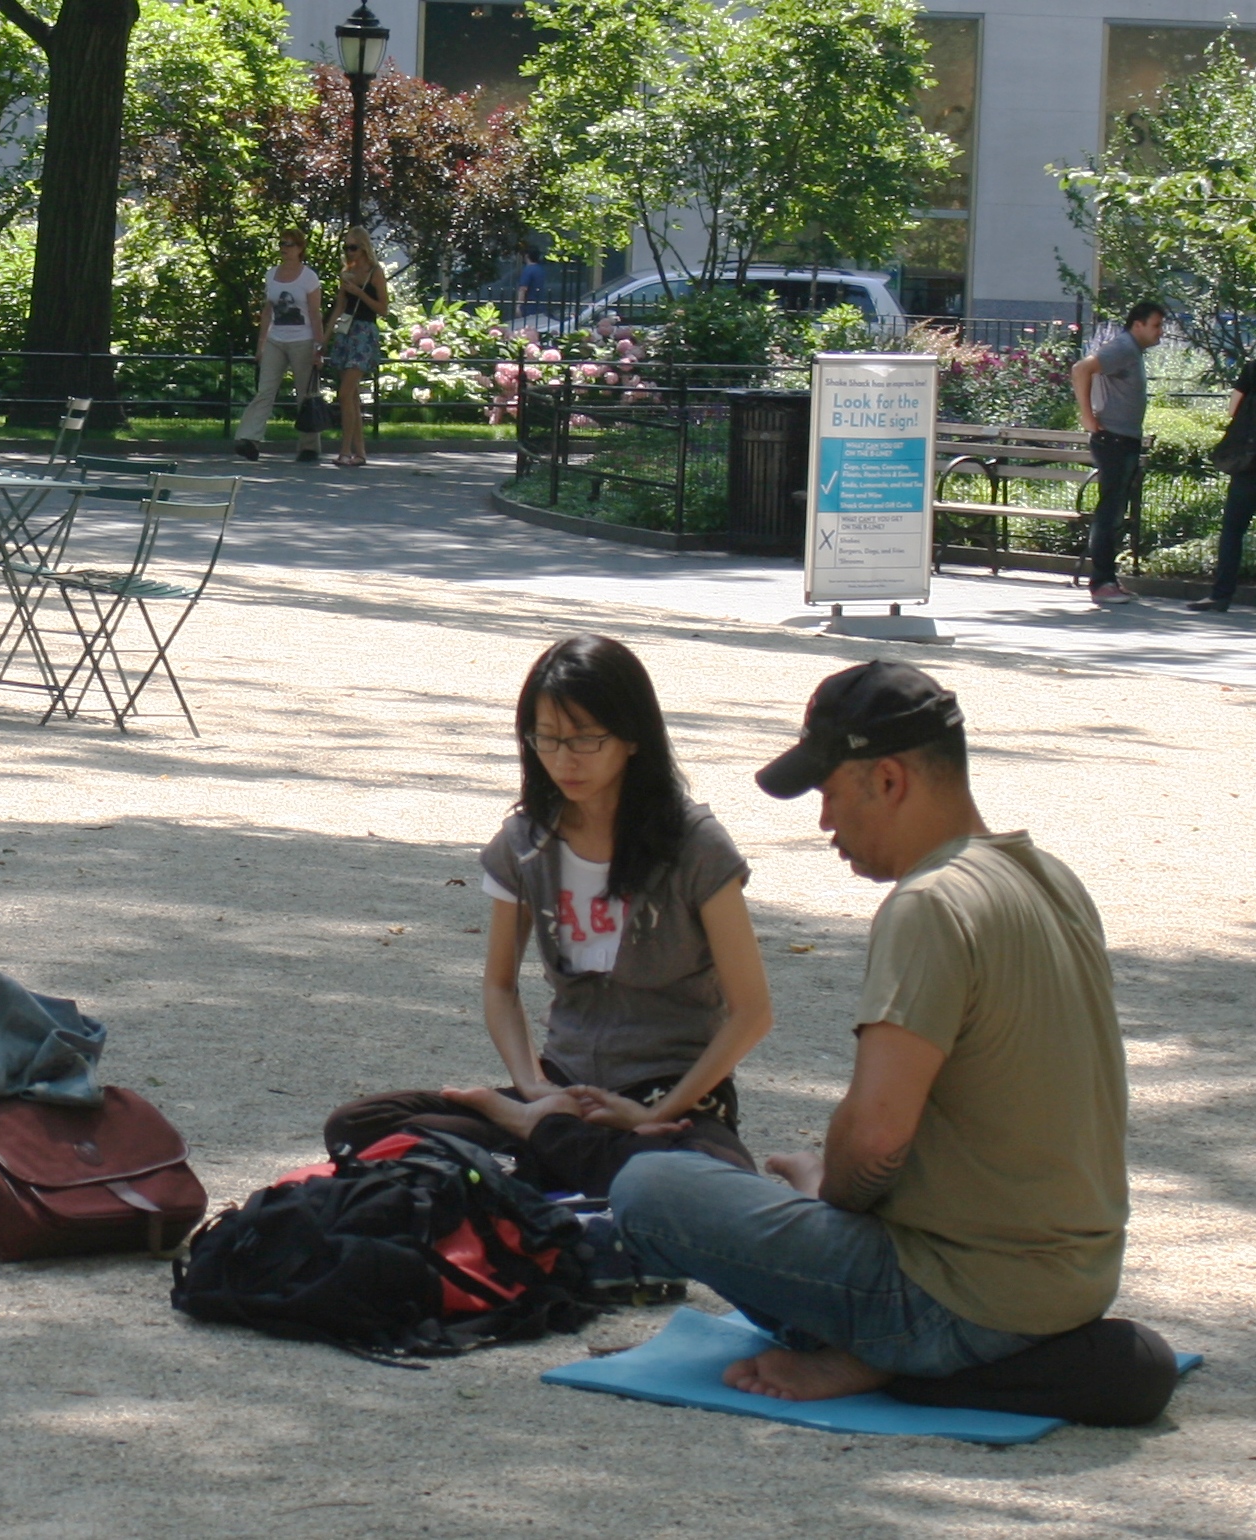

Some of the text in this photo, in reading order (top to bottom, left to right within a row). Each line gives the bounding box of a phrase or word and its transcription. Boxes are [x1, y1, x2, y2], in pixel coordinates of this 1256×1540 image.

[825, 378, 847, 387] Shake
[849, 378, 870, 387] Shack
[872, 379, 885, 387] has
[834, 392, 919, 409] Look for the
[832, 411, 918, 431] B-LINE sign!
[864, 442, 879, 450] CAN
